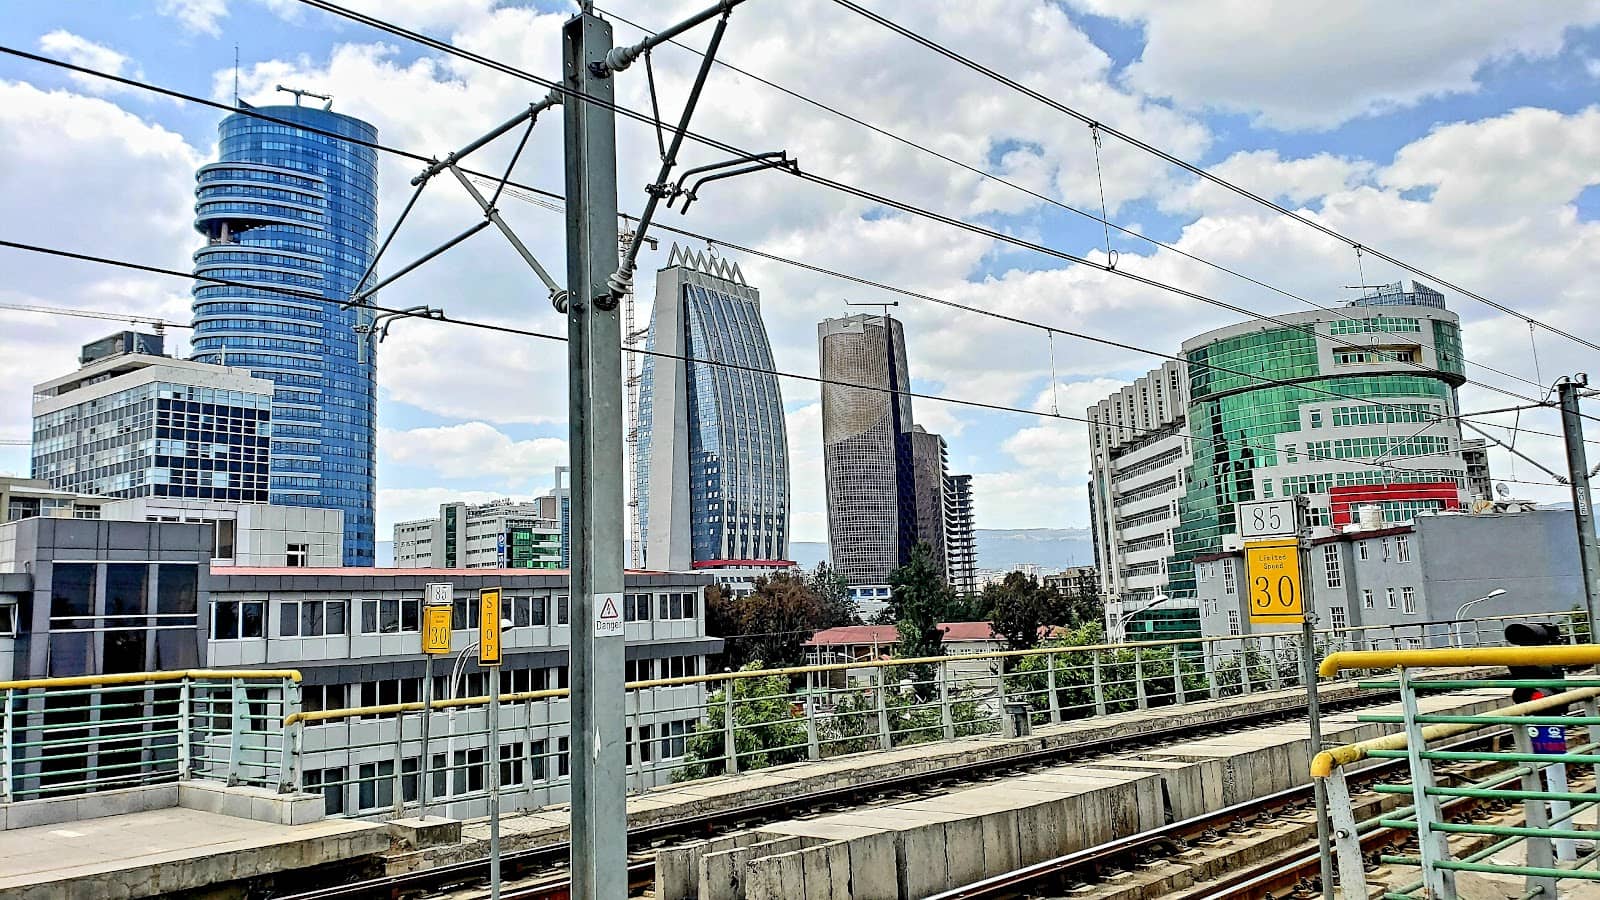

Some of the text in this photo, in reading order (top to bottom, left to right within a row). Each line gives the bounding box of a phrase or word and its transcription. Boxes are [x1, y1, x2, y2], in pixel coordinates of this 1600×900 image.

[1253, 506, 1281, 531] 85
[435, 586, 447, 601] 85
[1255, 575, 1294, 608] 30
[431, 626, 447, 645] 30
[596, 620, 622, 632] Danger
